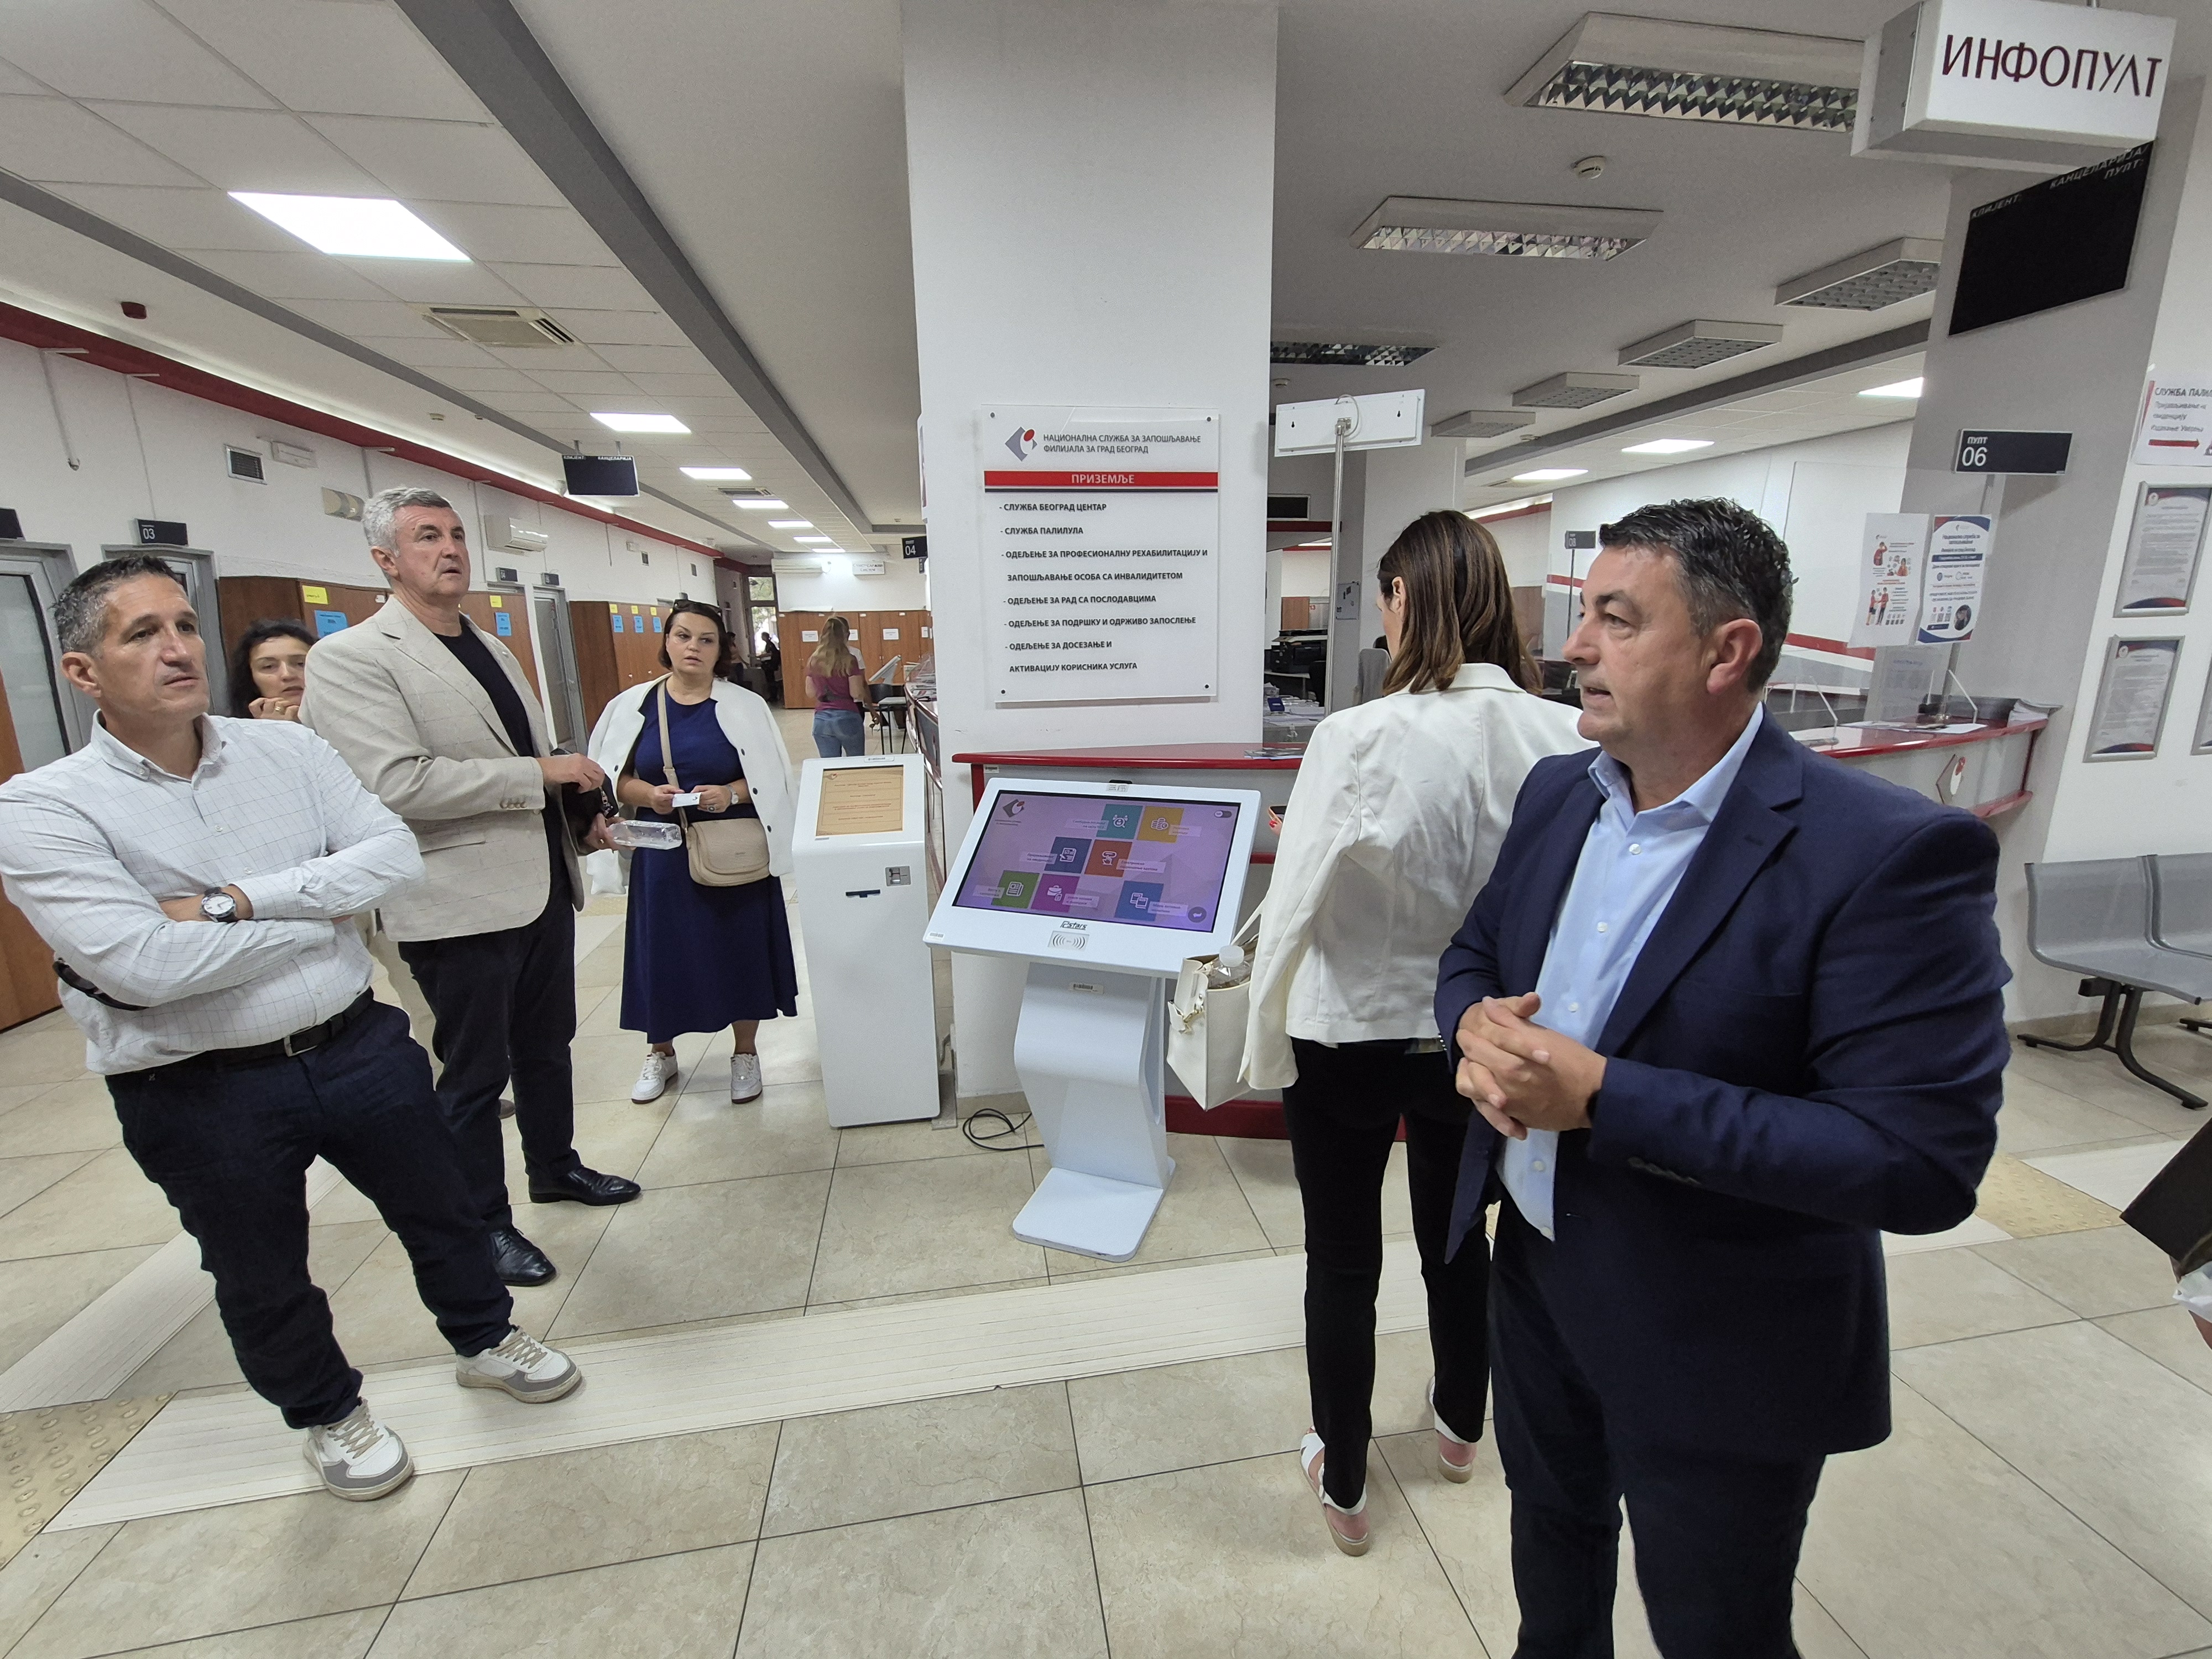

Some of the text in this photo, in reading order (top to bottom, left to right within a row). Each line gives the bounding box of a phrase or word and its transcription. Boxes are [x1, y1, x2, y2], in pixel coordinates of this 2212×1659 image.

[1942, 34, 2163, 97] ИНФОПУЛТ
[1043, 434, 1201, 443] НАЦИОНАЛНА СЛУЖБА ЗА ЗАПОШЉАВАЊЕ
[1044, 445, 1085, 453] ФИЛИЈАЛА
[1097, 445, 1115, 455] ГРАД
[1116, 445, 1149, 455] БЕОГРАД
[1962, 446, 1987, 467] 06
[1071, 473, 1135, 484] ПРИЗЕМЉЕ
[1039, 503, 1076, 513] БЕОГРАД
[1076, 503, 1107, 512] ЦЕНТАР
[143, 528, 155, 540] 03
[1004, 527, 1039, 535] СЛУЖБА
[905, 545, 916, 556] 04
[1005, 550, 1047, 560] ОДЕЉЕЊЕ
[1060, 550, 1131, 558] ПРОФЕСИОНАЛНУ
[1132, 549, 1201, 557] РЕХАБИЛИТАЦИЈУ
[1114, 572, 1183, 581] ИНВАЛИДИТЕТОМ
[1007, 597, 1048, 606] ОДЕЉЕЊЕ
[1061, 596, 1077, 605] РАД
[1090, 595, 1156, 604] ПОСЛОДАВЦИМА
[1008, 619, 1050, 629] ОДЕЉЕЊЕ
[1062, 618, 1101, 628] ПОДРШКУ
[1109, 618, 1149, 627] ОДРЖИВО
[1149, 617, 1196, 625] ЗАПОСЛЕЊЕ
[1009, 642, 1050, 651] ОДЕЉЕЊЕ
[1062, 641, 1105, 650] ДОСЕЗАЊЕ
[1009, 664, 1060, 673] АКТИВАЦИЈУ
[1061, 663, 1108, 671] КОРИСНИКА
